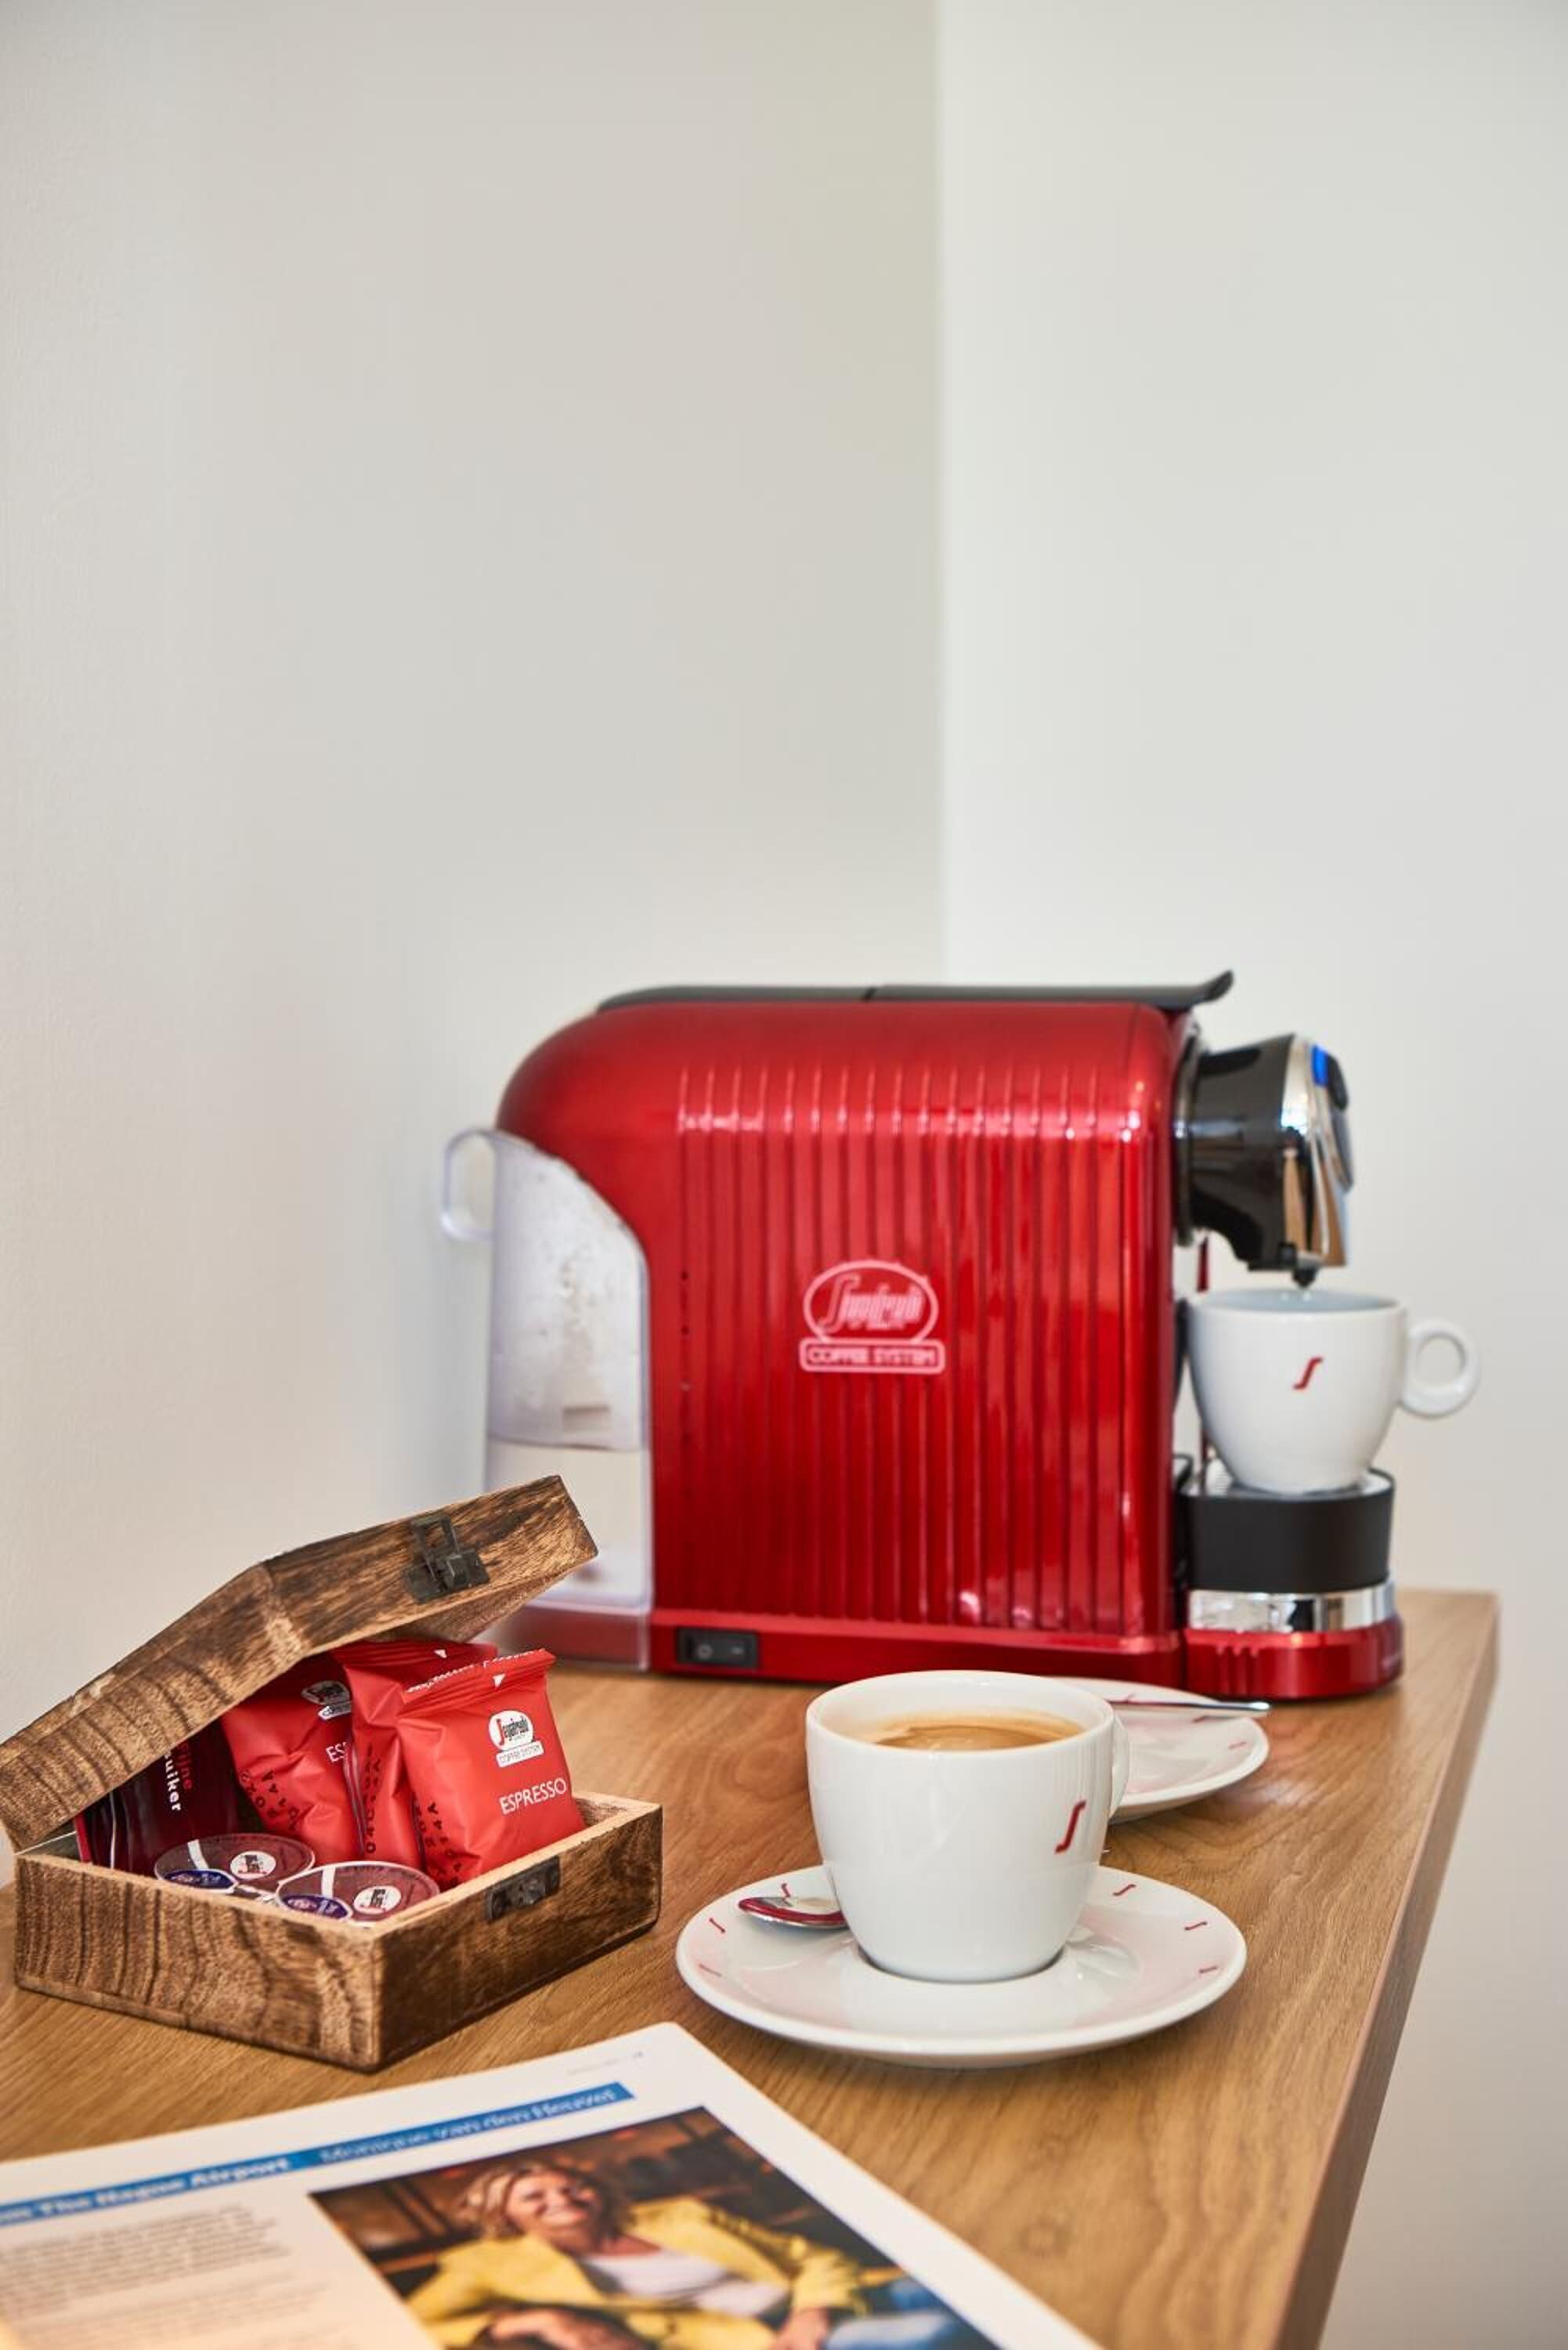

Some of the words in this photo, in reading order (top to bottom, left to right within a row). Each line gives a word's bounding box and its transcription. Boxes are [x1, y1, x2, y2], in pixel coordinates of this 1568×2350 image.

[326, 1742, 346, 1762] ES
[499, 1777, 567, 1815] ESPRESSO
[190, 2157, 291, 2189] Airport
